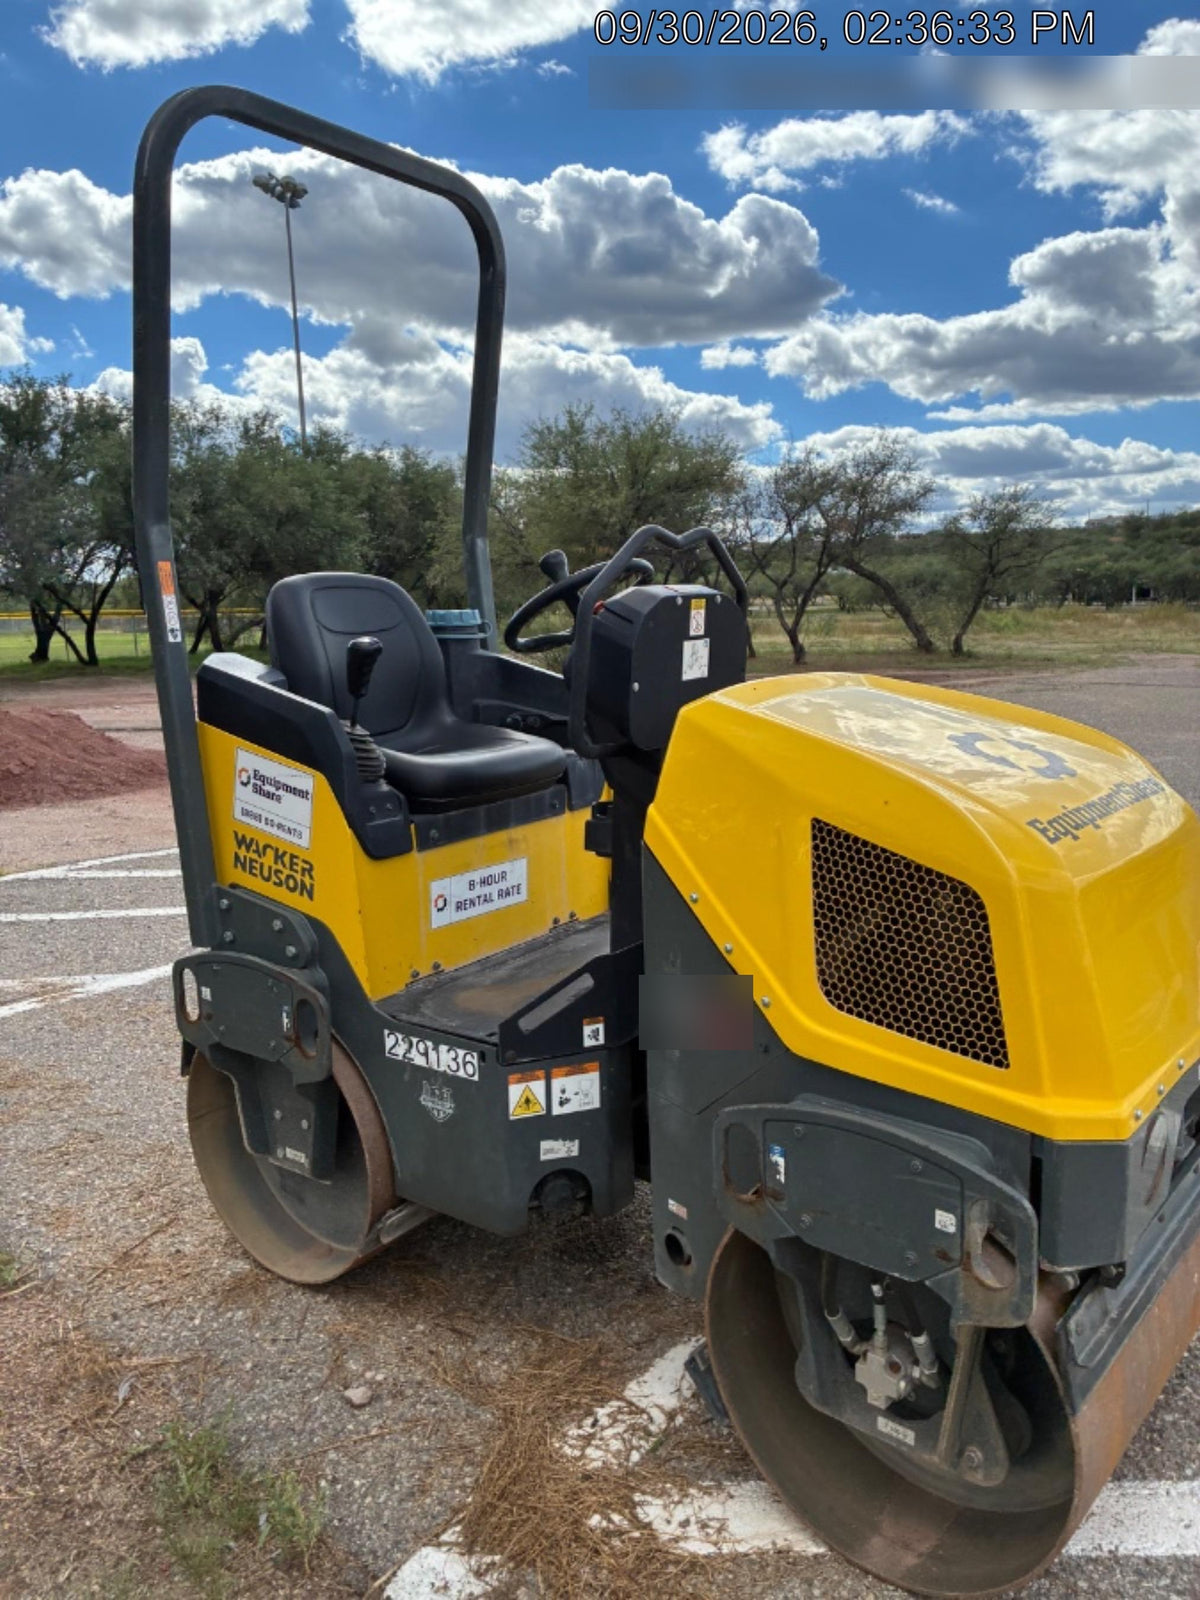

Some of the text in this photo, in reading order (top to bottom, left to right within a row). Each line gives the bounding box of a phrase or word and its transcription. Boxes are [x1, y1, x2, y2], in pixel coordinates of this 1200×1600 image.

[251, 769, 310, 801] Equipment
[251, 783, 282, 805] Share
[233, 830, 315, 881] WACKER
[233, 851, 315, 902] NEUSON
[468, 870, 508, 891] 8-HOUR
[455, 882, 522, 912] RENTAL RATE
[386, 1031, 477, 1078] 229136
